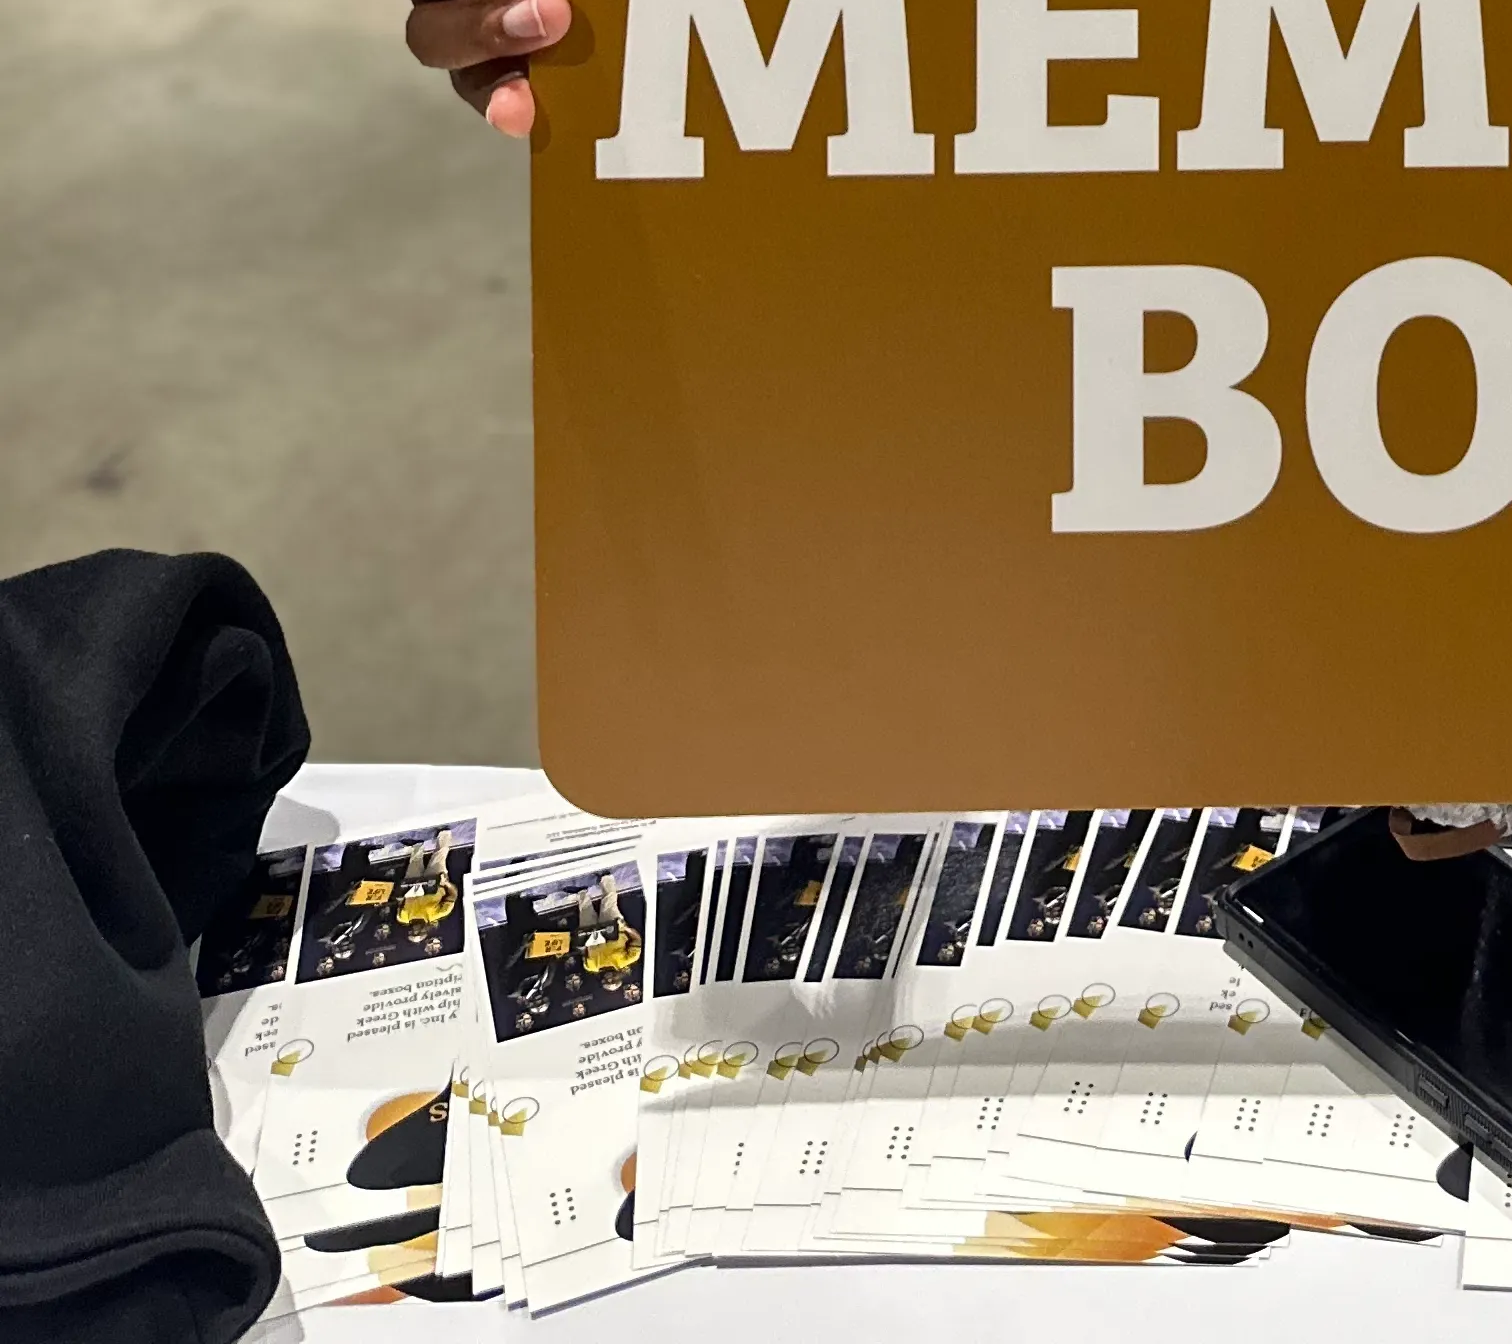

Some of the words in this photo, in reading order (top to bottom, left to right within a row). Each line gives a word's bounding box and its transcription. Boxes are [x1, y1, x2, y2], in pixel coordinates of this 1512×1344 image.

[363, 993, 418, 1012] provide
[402, 1004, 435, 1016] with
[355, 1011, 399, 1027] Greek
[404, 1020, 416, 1030] is
[347, 1021, 401, 1042] pleased
[578, 1040, 633, 1064] provide
[621, 1054, 642, 1065] ith
[575, 1061, 619, 1079] Greek
[628, 1068, 639, 1076] is
[570, 1070, 624, 1095] pleased
